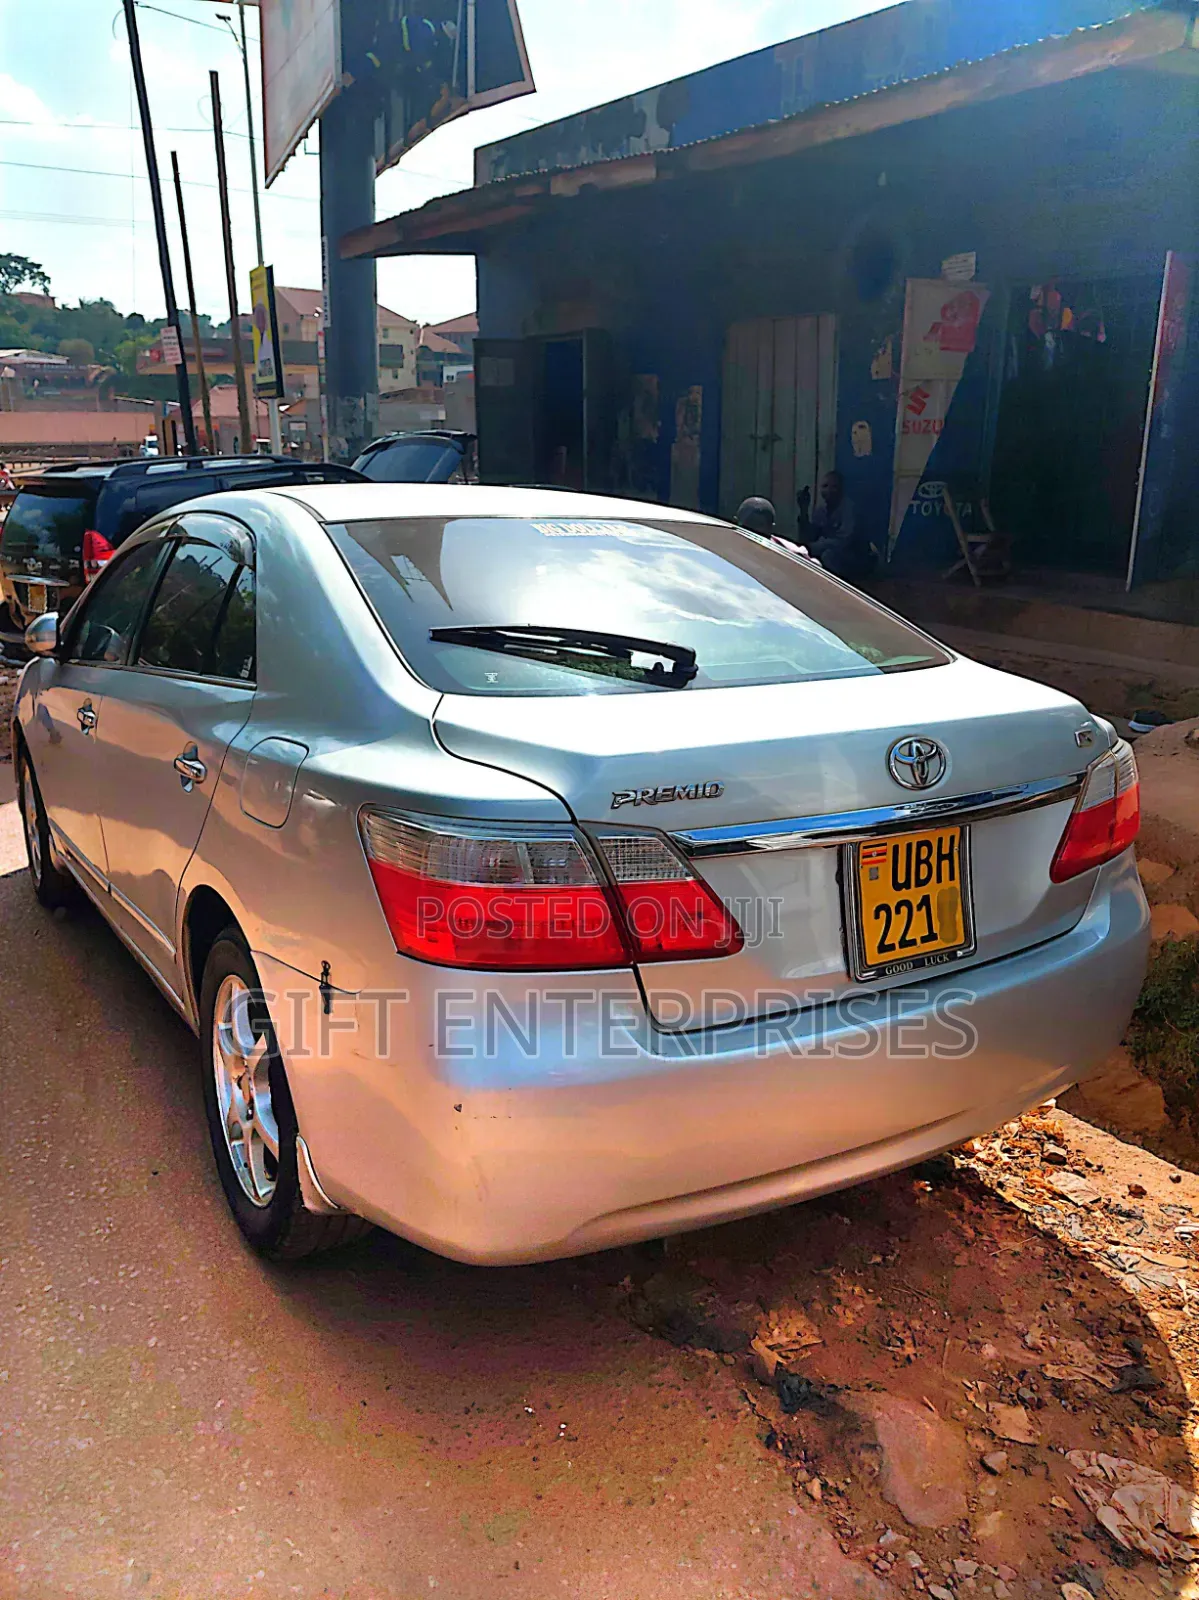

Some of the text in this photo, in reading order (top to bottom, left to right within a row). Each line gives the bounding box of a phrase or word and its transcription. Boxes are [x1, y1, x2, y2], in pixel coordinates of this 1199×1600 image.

[910, 500, 972, 517] TOYTA
[610, 780, 725, 810] PREMIO
[891, 834, 956, 892] UBH
[885, 953, 951, 975] GOOD LUCK
